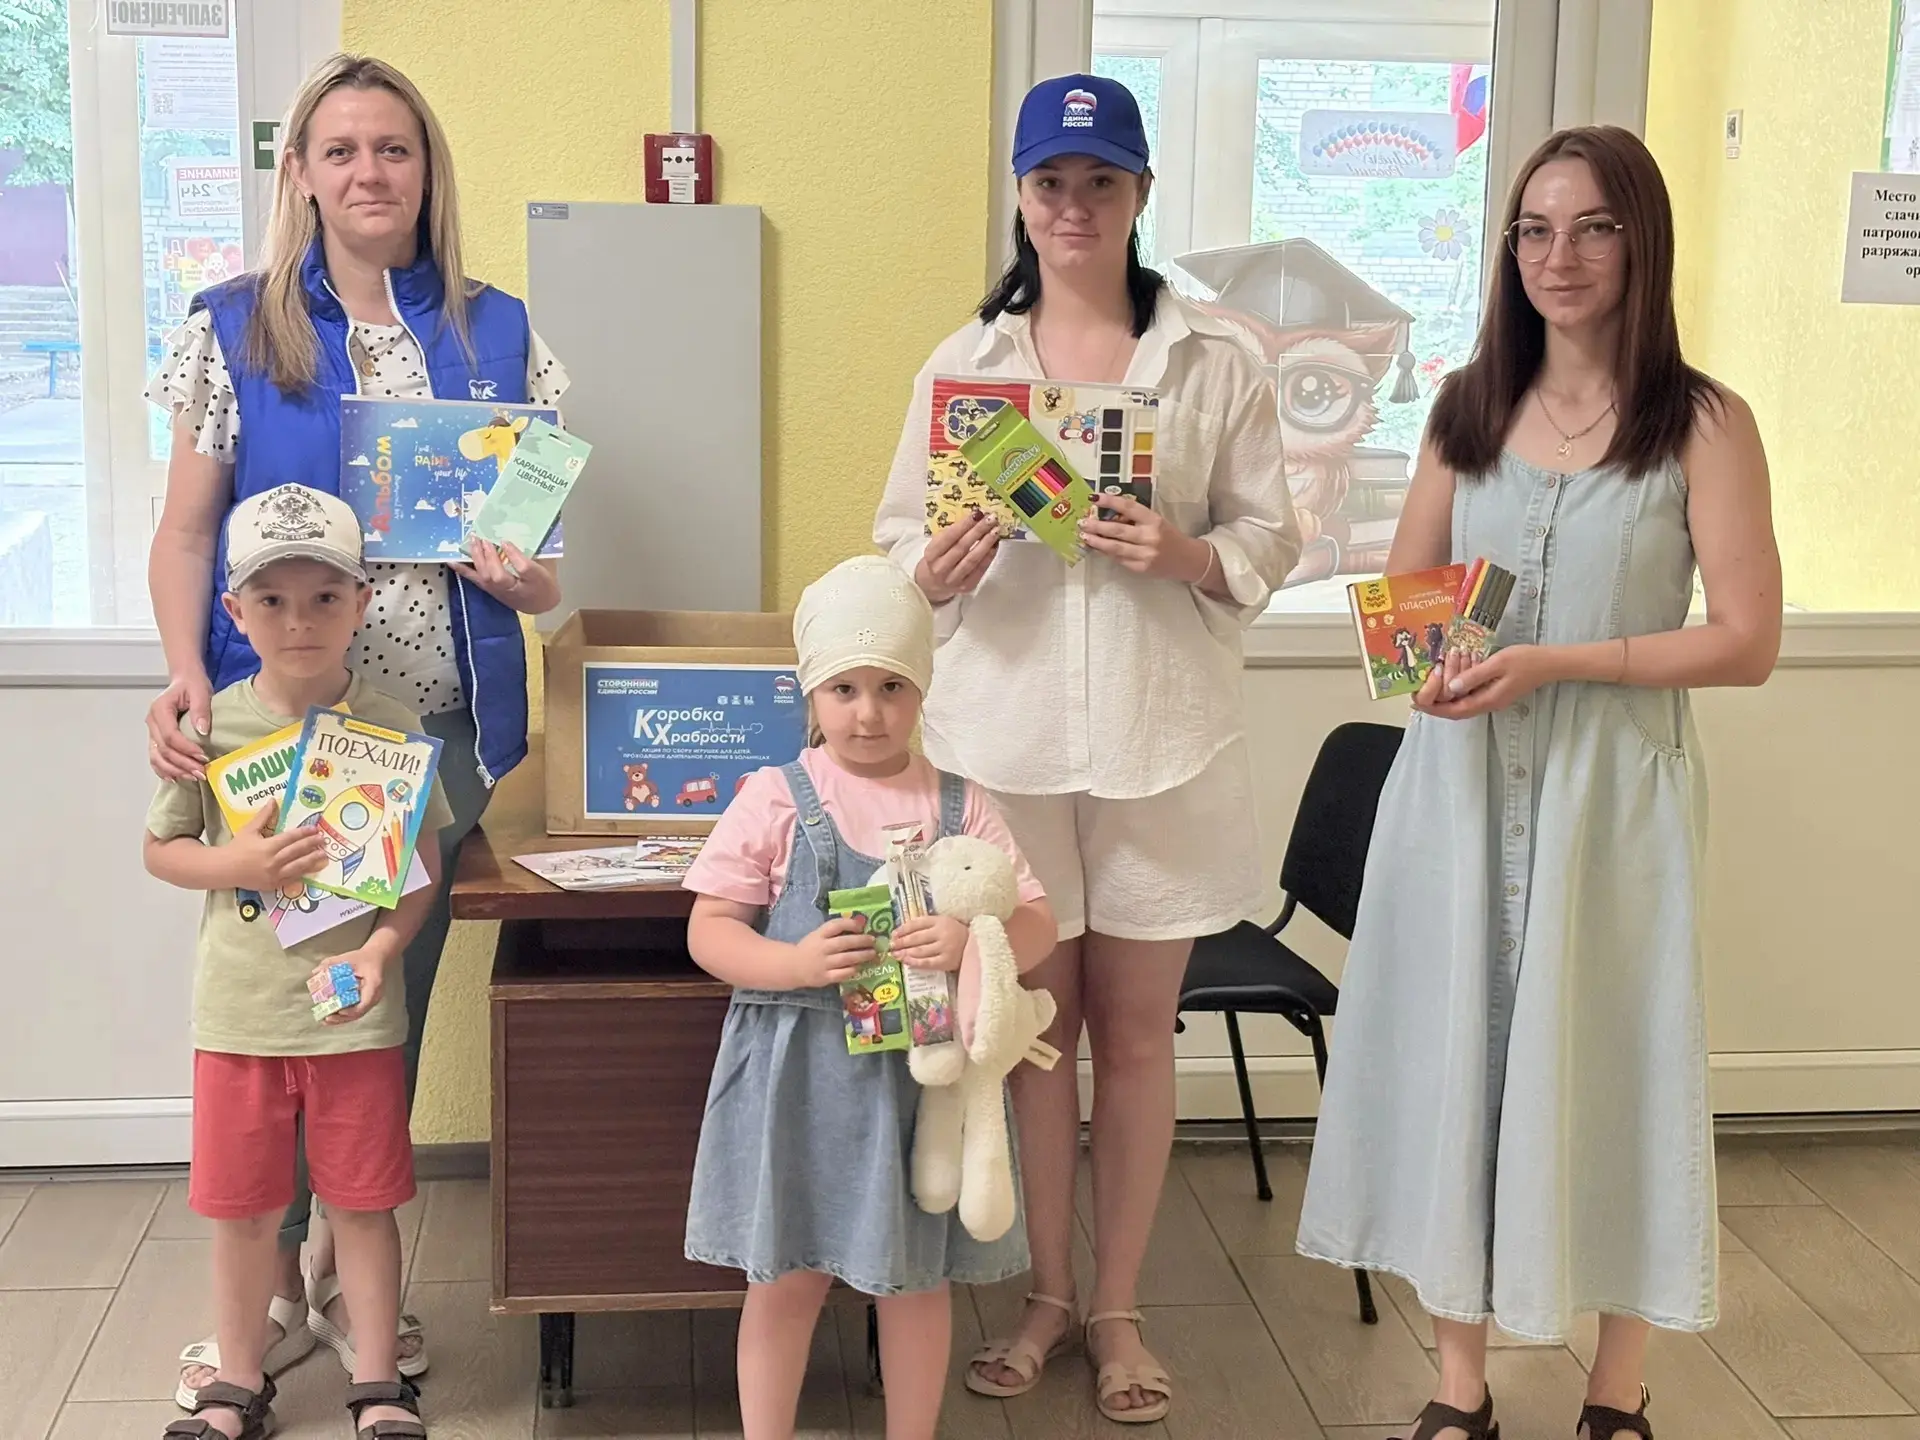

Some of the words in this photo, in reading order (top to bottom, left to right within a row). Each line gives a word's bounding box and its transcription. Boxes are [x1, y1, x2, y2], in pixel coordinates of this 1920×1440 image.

[1874, 189, 1917, 202] Место
[1862, 247, 1920, 259] разряжа
[513, 456, 569, 489] КАРАНДАШИ
[516, 468, 556, 493] ЦВЕТНЫЕ
[369, 435, 392, 533] Альбом
[1054, 503, 1068, 515] 12
[1399, 595, 1455, 612] ПЛАСТИЛИН
[598, 679, 658, 688] СТОРОННИКИ
[633, 707, 725, 739] Коробка
[651, 723, 746, 746] Храбрости
[318, 733, 421, 776] ПОЕХАЛИ!
[225, 743, 299, 796] МАШИ
[367, 882, 383, 895] 2+
[880, 987, 892, 996] 12
